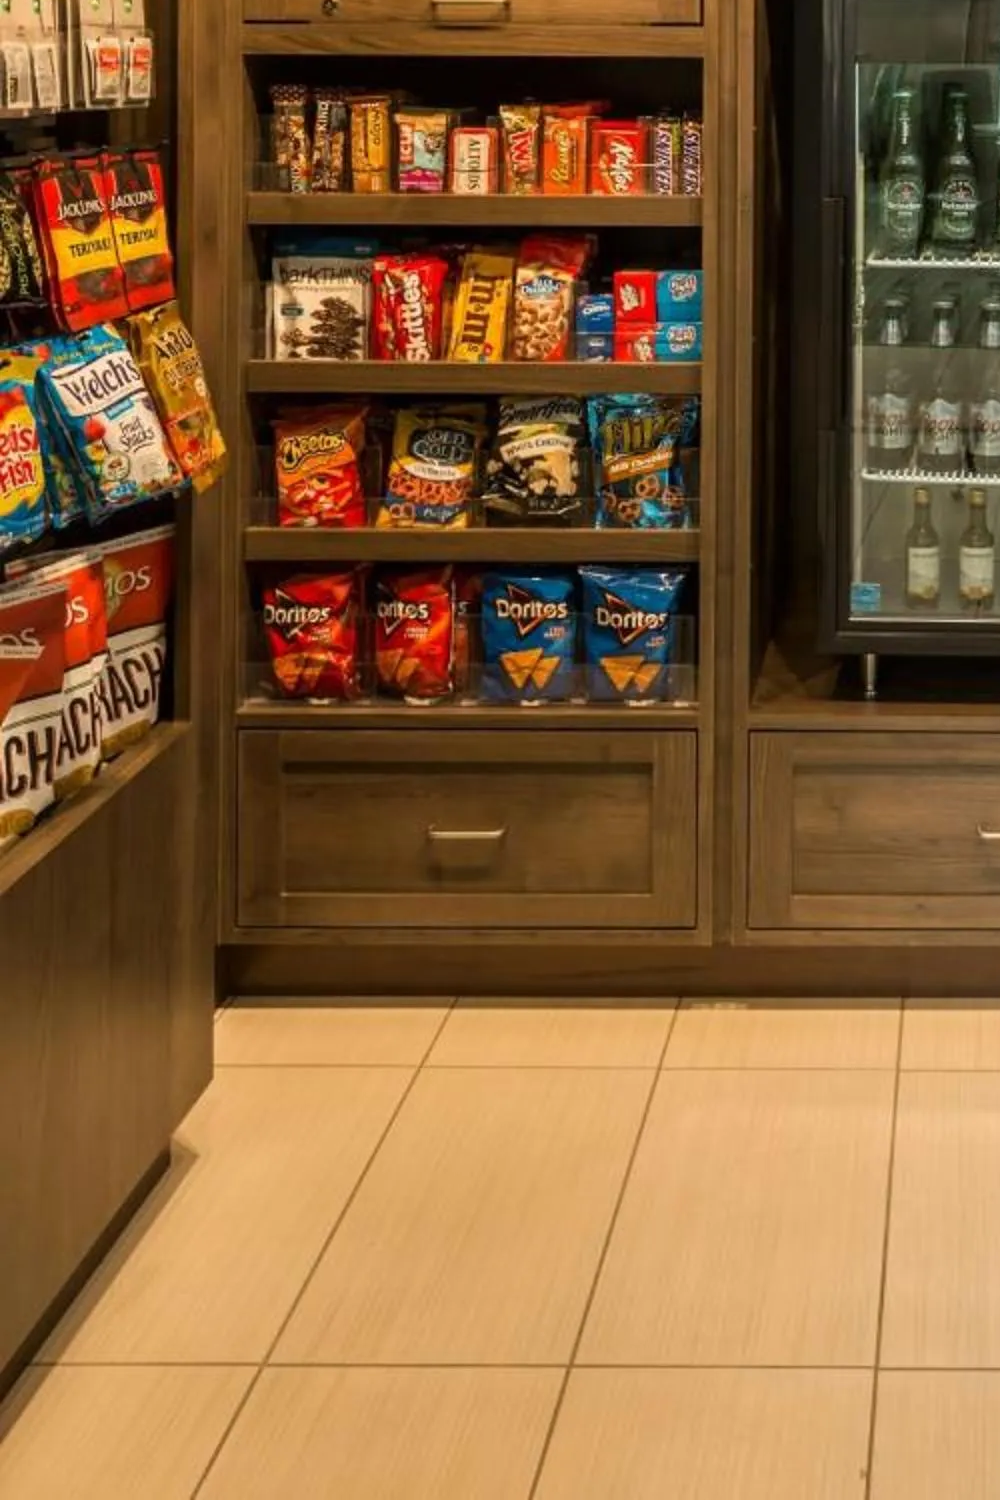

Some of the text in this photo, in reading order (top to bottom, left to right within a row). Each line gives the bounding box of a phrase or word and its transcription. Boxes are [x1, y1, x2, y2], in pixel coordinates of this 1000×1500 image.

[402, 272, 431, 361] Skittles
[60, 356, 141, 407] Welch's
[279, 431, 346, 471] Cheetos
[264, 604, 332, 625] Doritos
[377, 600, 429, 620] oritos
[496, 598, 568, 619] Doritos
[597, 606, 667, 629] Doritos
